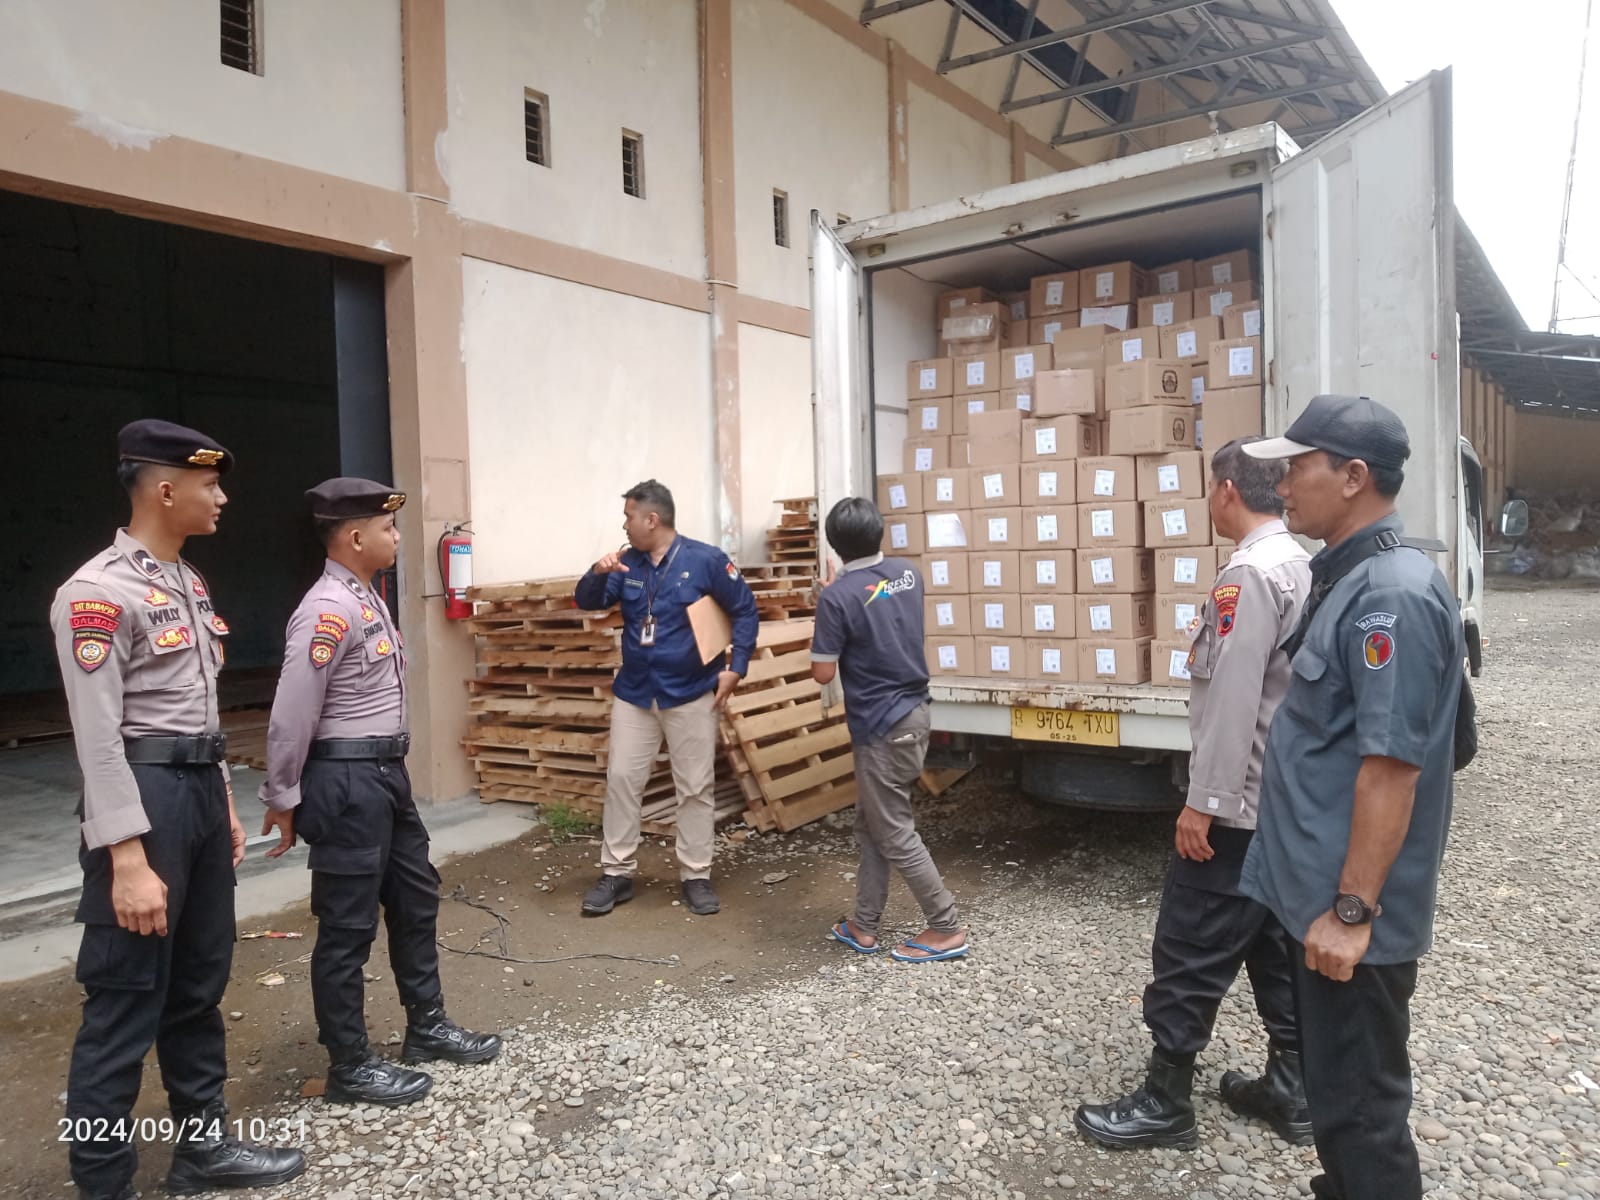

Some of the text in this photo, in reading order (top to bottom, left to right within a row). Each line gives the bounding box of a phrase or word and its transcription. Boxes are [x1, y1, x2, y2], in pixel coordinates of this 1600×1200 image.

[196, 600, 214, 614] POL
[73, 617, 116, 630] DALMAS
[148, 608, 181, 625] WILLY
[1360, 615, 1393, 628] BAWASLU
[1036, 711, 1074, 731] 9764
[1085, 714, 1114, 734] TXU
